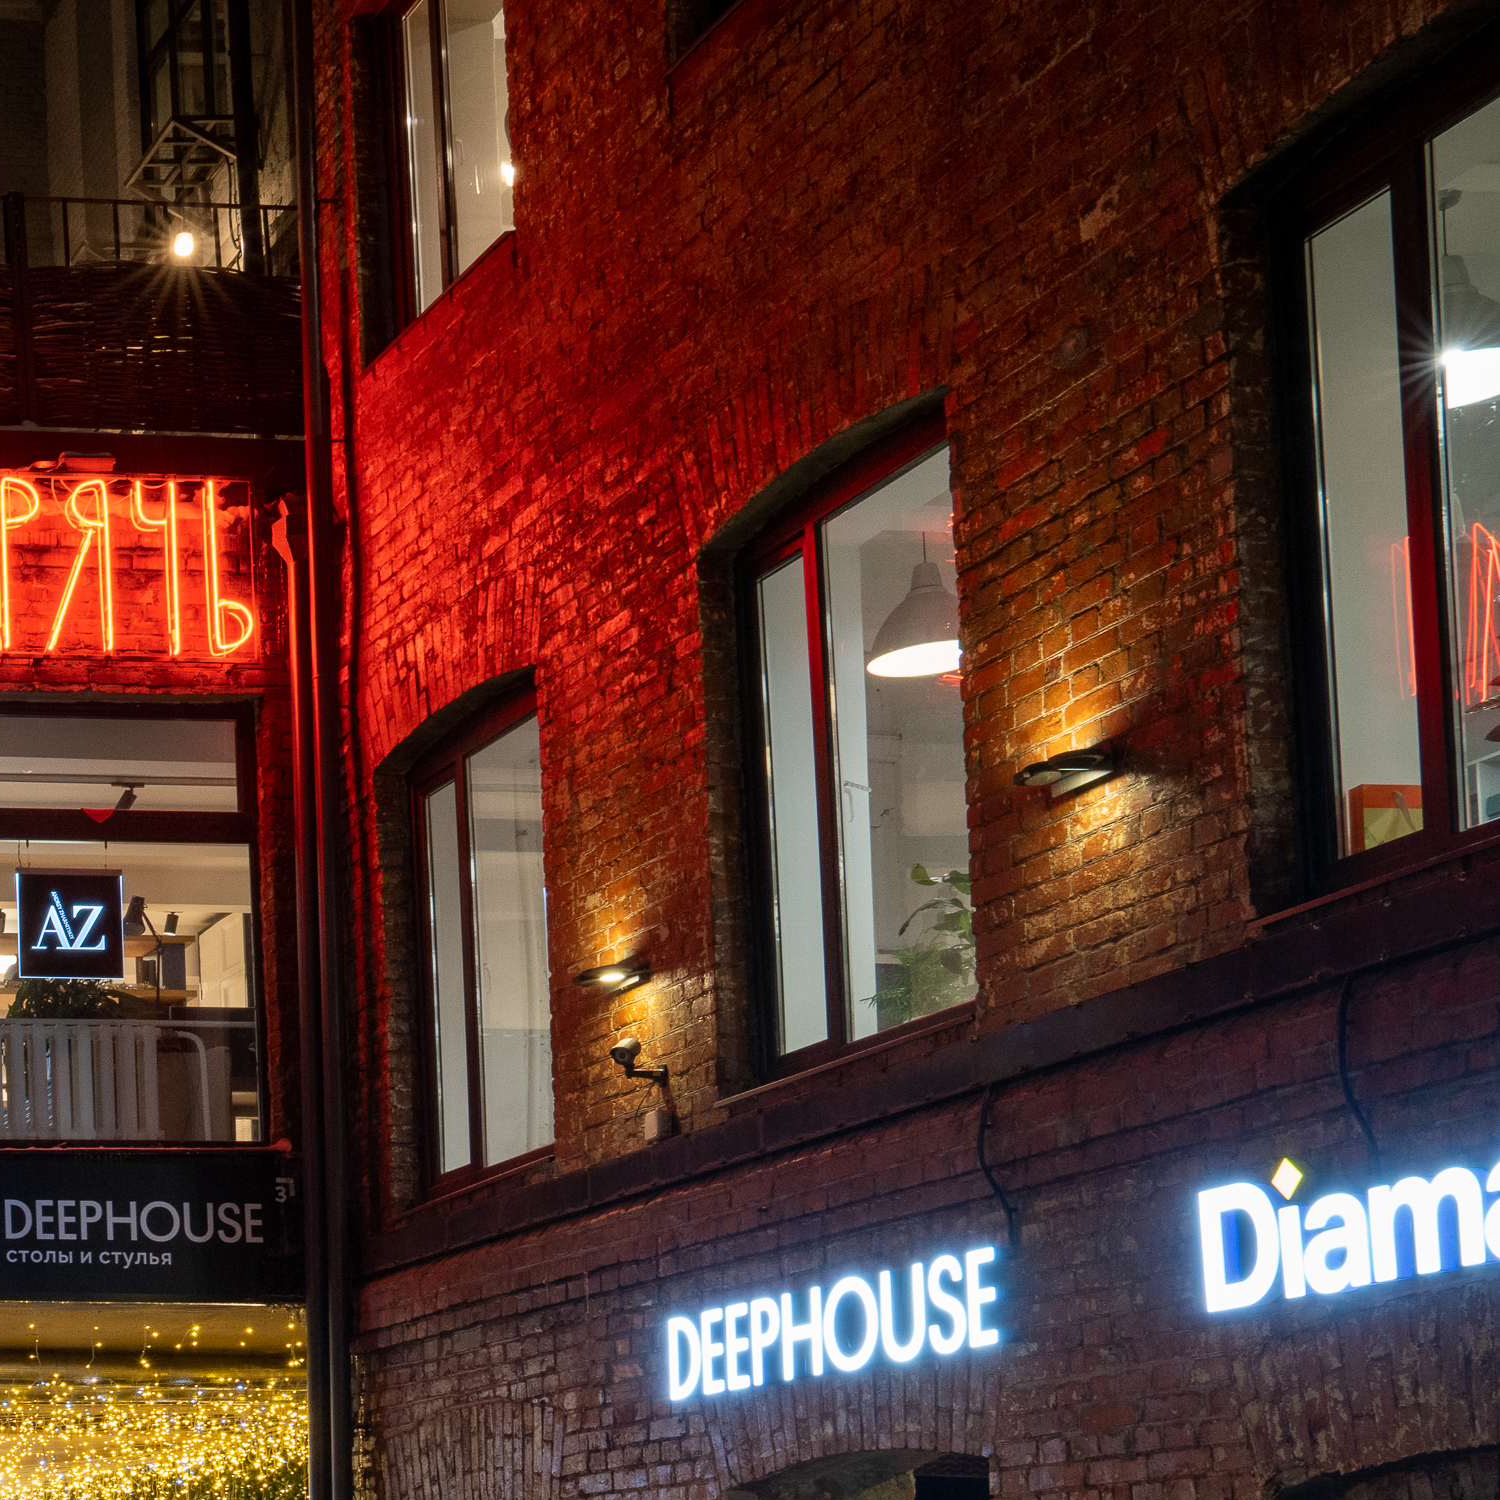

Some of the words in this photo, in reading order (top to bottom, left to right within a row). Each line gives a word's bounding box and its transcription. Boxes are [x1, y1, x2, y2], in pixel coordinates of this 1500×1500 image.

[31, 905, 106, 950] AZ
[4, 1198, 264, 1243] DEEPHOUSE
[6, 1250, 73, 1264] столы
[80, 1251, 93, 1264] и
[99, 1251, 172, 1269] стулья
[666, 1245, 1000, 1402] DEEPHOUSE
